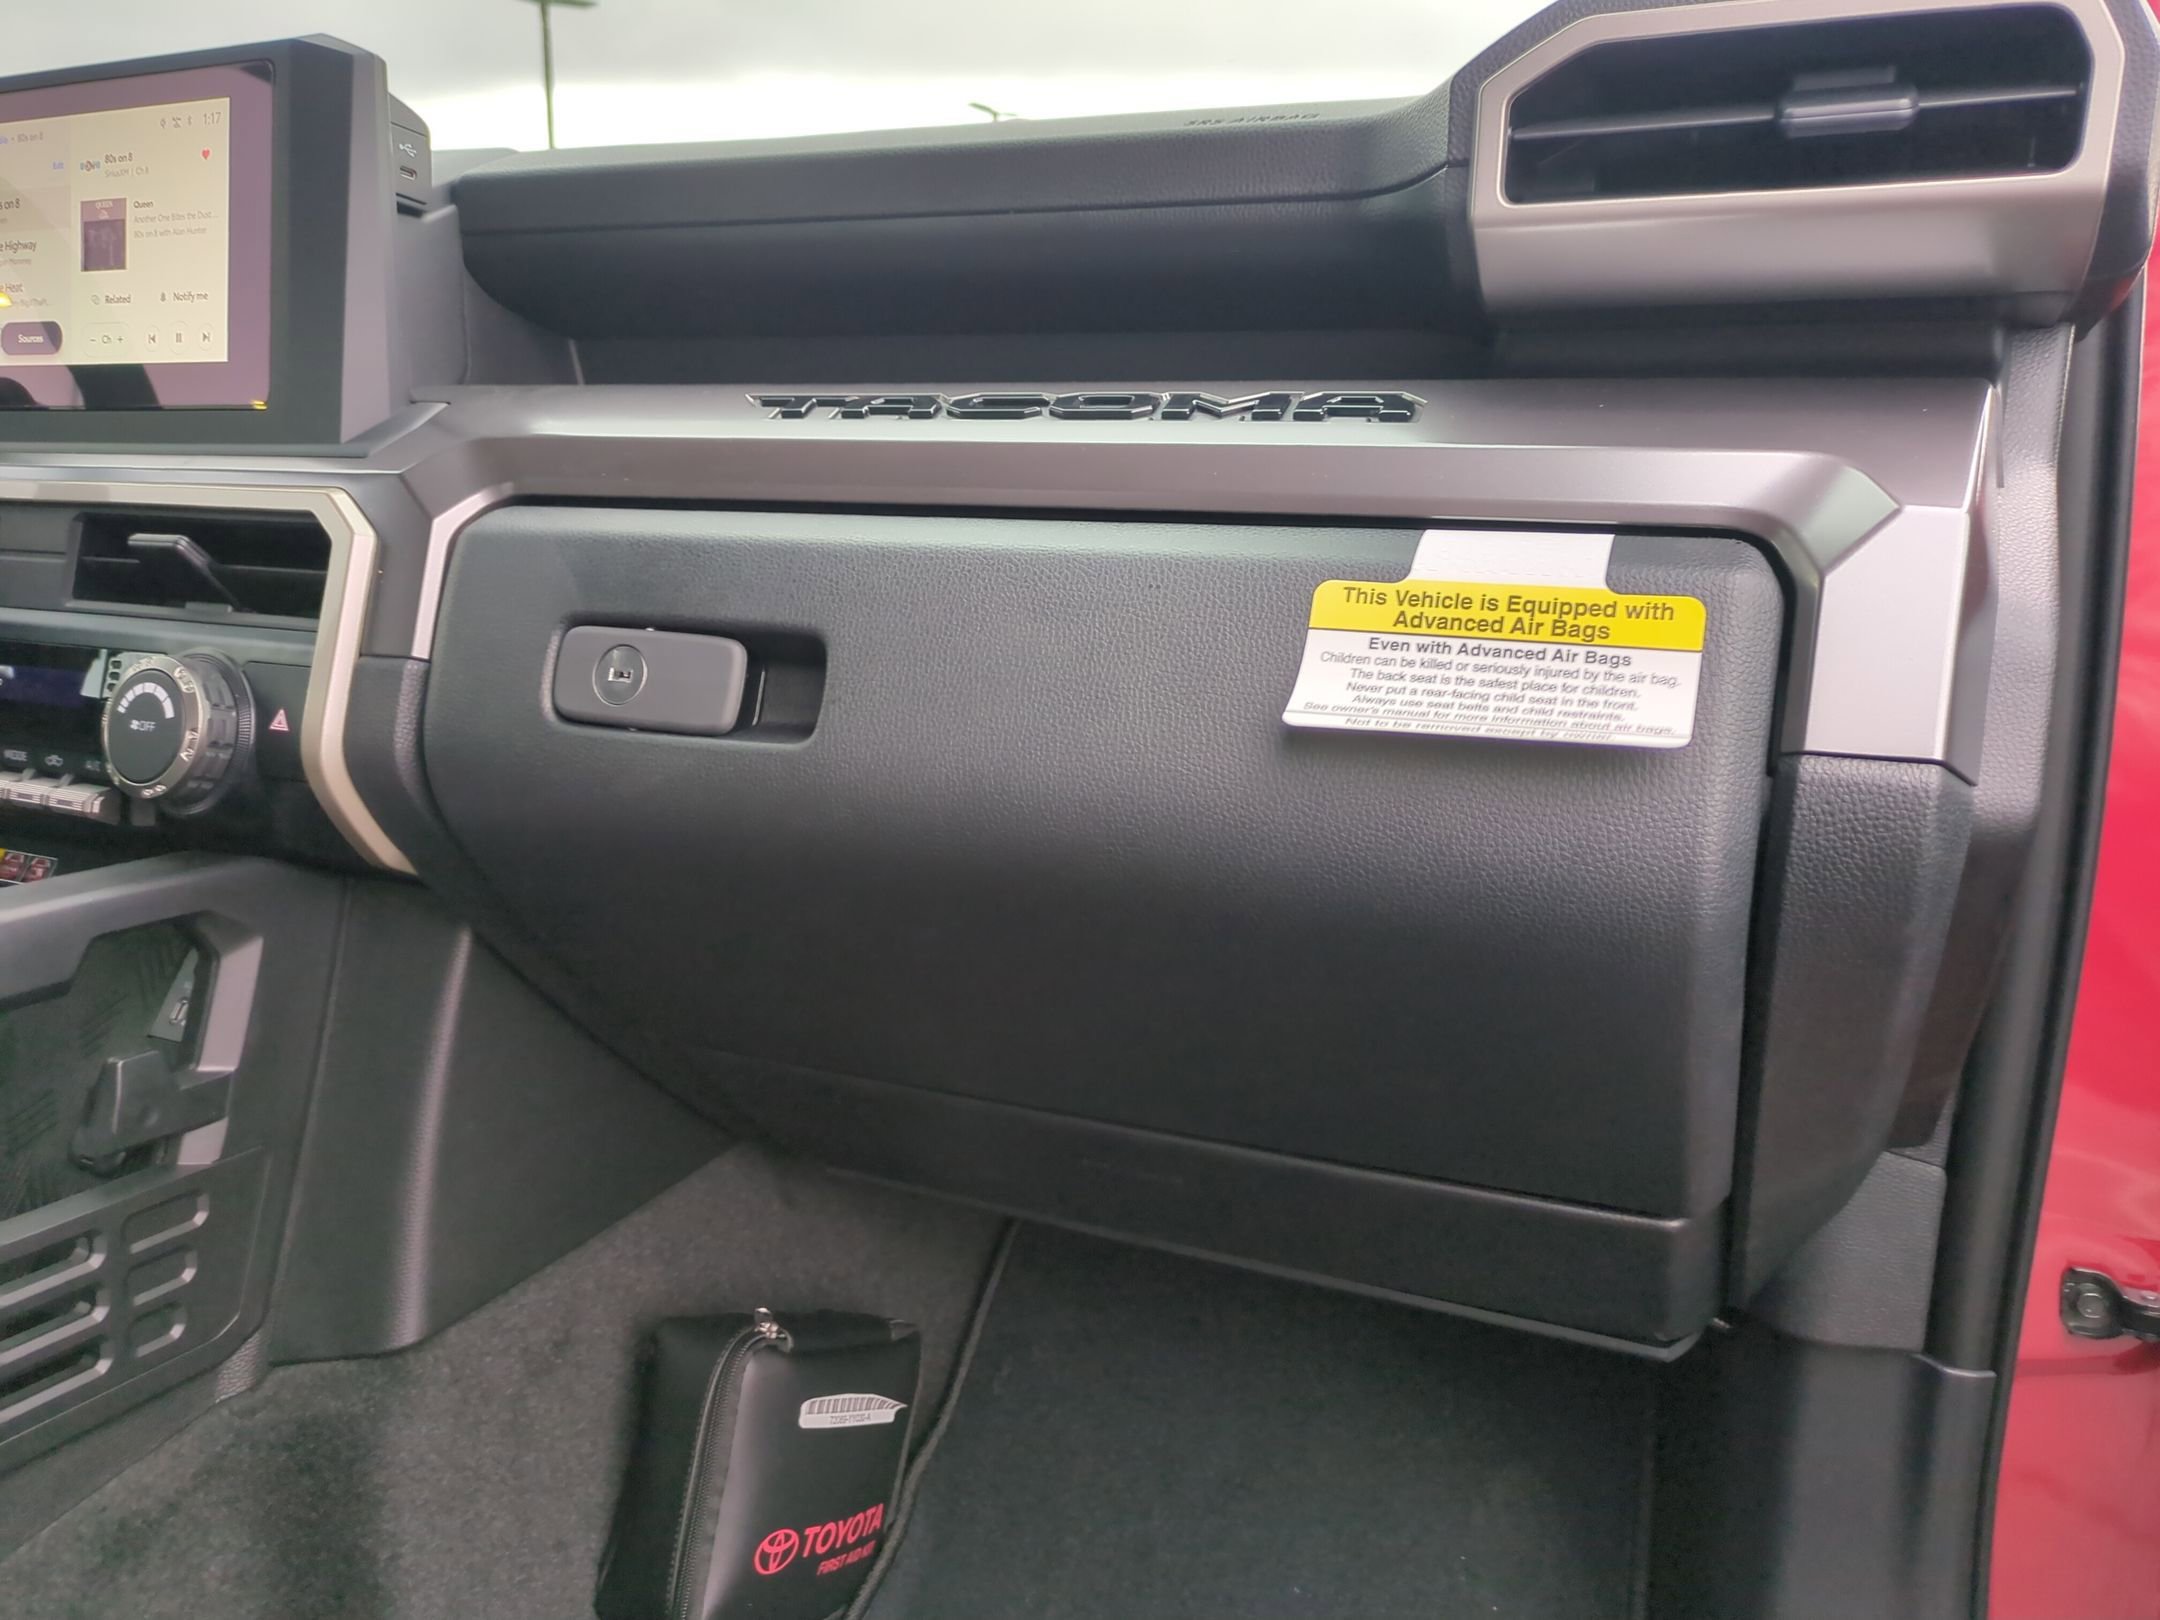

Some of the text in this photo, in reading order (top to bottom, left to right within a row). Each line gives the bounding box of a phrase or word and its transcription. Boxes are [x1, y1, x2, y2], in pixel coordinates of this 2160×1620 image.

[203, 112, 221, 125] 1:17
[104, 153, 117, 164] 80s
[118, 154, 127, 162] on
[133, 201, 154, 209] Queen
[5, 240, 37, 254] Highway
[104, 295, 131, 304] Related
[173, 291, 209, 303] Notify me
[746, 391, 1427, 422] TACOMA
[1344, 587, 1676, 621] This Vehicle is Equipped with
[1393, 611, 1611, 643] Advanced Air Bags
[1369, 637, 1632, 669] Even with Advanced Air Bags
[1320, 651, 1371, 665] Children
[1374, 657, 1397, 667] can
[1400, 657, 1416, 669] be
[1419, 658, 1452, 671] killed
[1455, 662, 1468, 672] or
[1472, 662, 1531, 678] seriously
[1534, 665, 1580, 680] injured
[1583, 668, 1600, 683] by
[1603, 670, 1625, 683] the
[1628, 672, 1647, 684] air
[1346, 682, 1639, 712] Never put a rear-facing child seat in the front.
[1351, 668, 1641, 699] The back seat is the safest place for children.
[1303, 702, 1328, 711] See
[1331, 703, 1380, 715] owner's
[1382, 707, 1430, 719] manual
[1433, 710, 1451, 720] for
[1453, 713, 1488, 722] more
[1491, 714, 1568, 728] information
[1570, 720, 1612, 731] about
[1614, 723, 1633, 733] air
[1352, 695, 1626, 723] Always use seat belts and child restraints.
[140, 721, 156, 732] OFF
[1345, 717, 1372, 727] Not
[1375, 718, 1390, 727] to
[1393, 718, 1412, 729] be
[1415, 720, 1483, 733] removed
[1484, 727, 1537, 739] except
[1540, 730, 1560, 740] by
[802, 1503, 884, 1558] TOYOTA
[817, 1552, 847, 1576] FIRST
